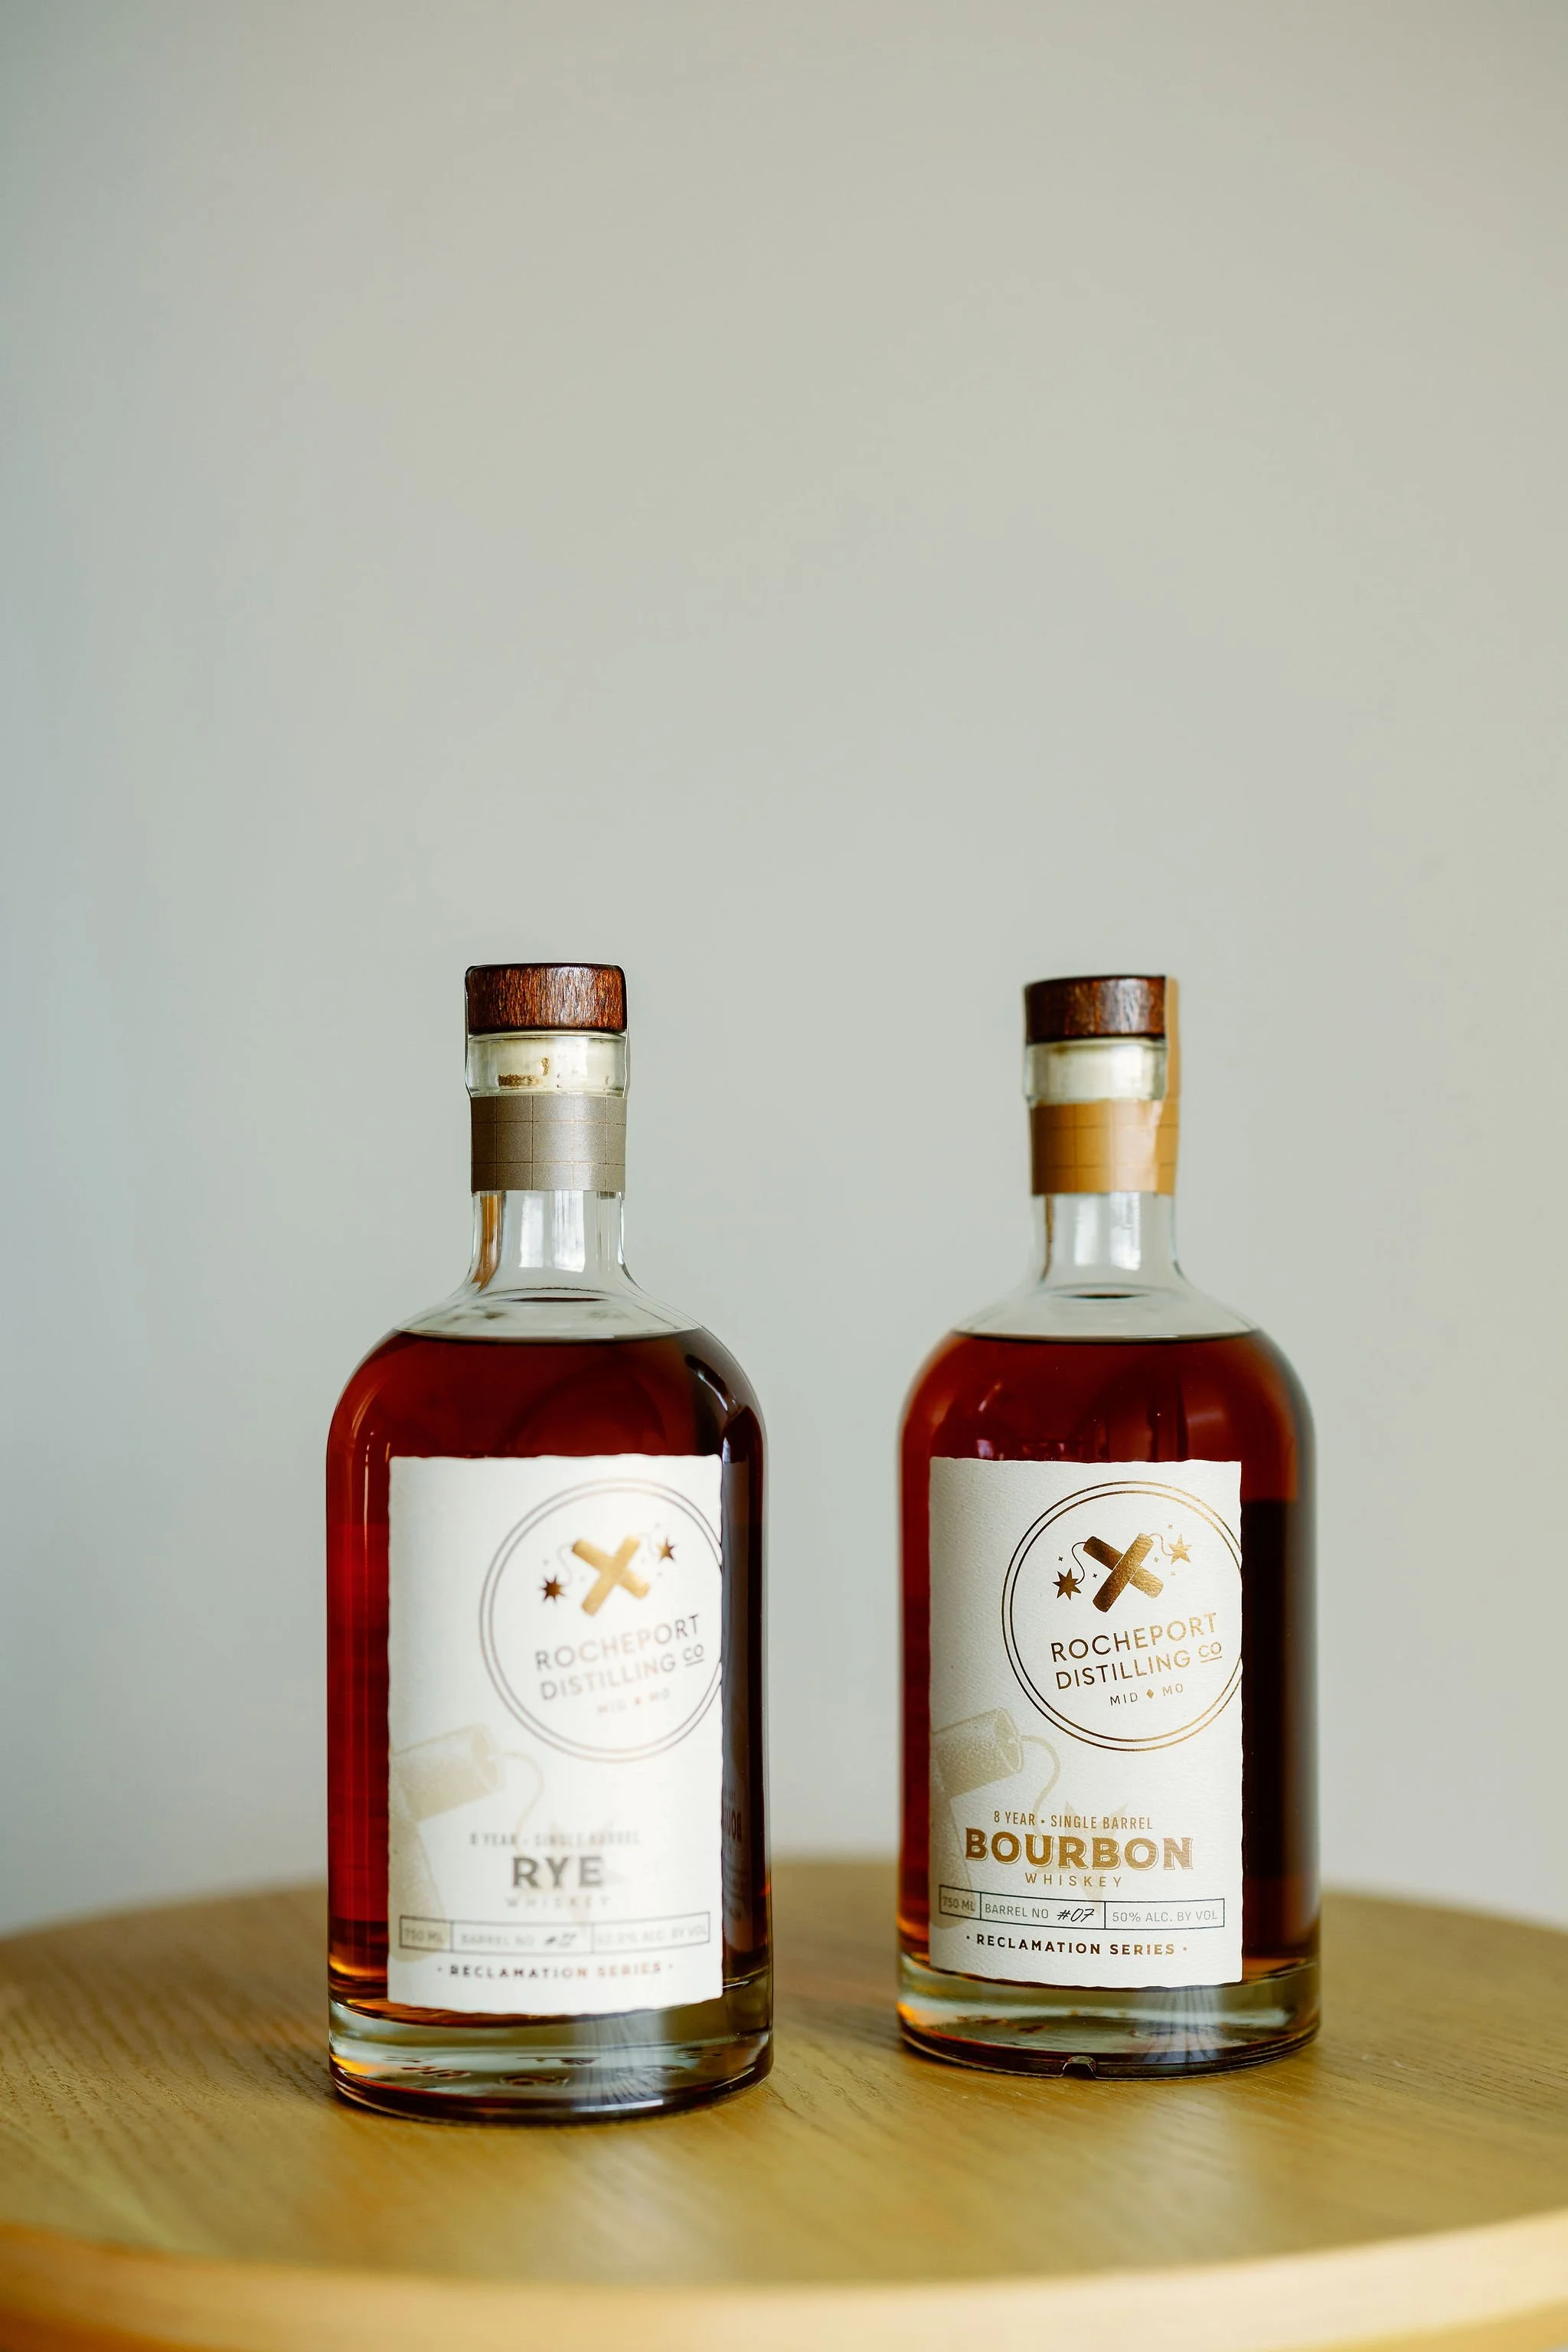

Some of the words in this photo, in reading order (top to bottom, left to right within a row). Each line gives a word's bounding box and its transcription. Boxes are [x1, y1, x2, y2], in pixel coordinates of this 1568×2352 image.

[535, 1613, 699, 1672] ROCHEPORT
[1050, 1612, 1217, 1663] ROCHEPORT
[541, 1653, 676, 1700] DISTILLING
[683, 1644, 704, 1661] CO
[1055, 1649, 1191, 1690] DISTILLING
[1197, 1642, 1222, 1658] CO
[1109, 1692, 1138, 1706] MID
[1162, 1683, 1184, 1696] MO
[994, 1811, 1000, 1823] 8
[1004, 1811, 1036, 1826] YEAR
[1050, 1815, 1097, 1829] SINGLE
[1102, 1816, 1153, 1830] BARREL
[965, 1827, 1194, 1871] BOURBON
[511, 1856, 603, 1889] RYE
[1025, 1872, 1122, 1887] WHISKEY
[942, 1896, 959, 1909] 750
[961, 1900, 975, 1912] ML
[985, 1903, 1028, 1917] BARREL
[1031, 1908, 1049, 1919] NO
[1057, 1908, 1095, 1922] #07
[1112, 1911, 1141, 1922] 50%
[1145, 1911, 1173, 1922] ALC.
[1177, 1911, 1191, 1922] BY
[1195, 1909, 1218, 1920] VOL
[976, 1933, 1100, 1955] RECLAMATION
[1110, 1943, 1175, 1955] SERIES
[449, 1964, 587, 1979] RECLAMATION
[598, 1962, 662, 1978] SERIES
